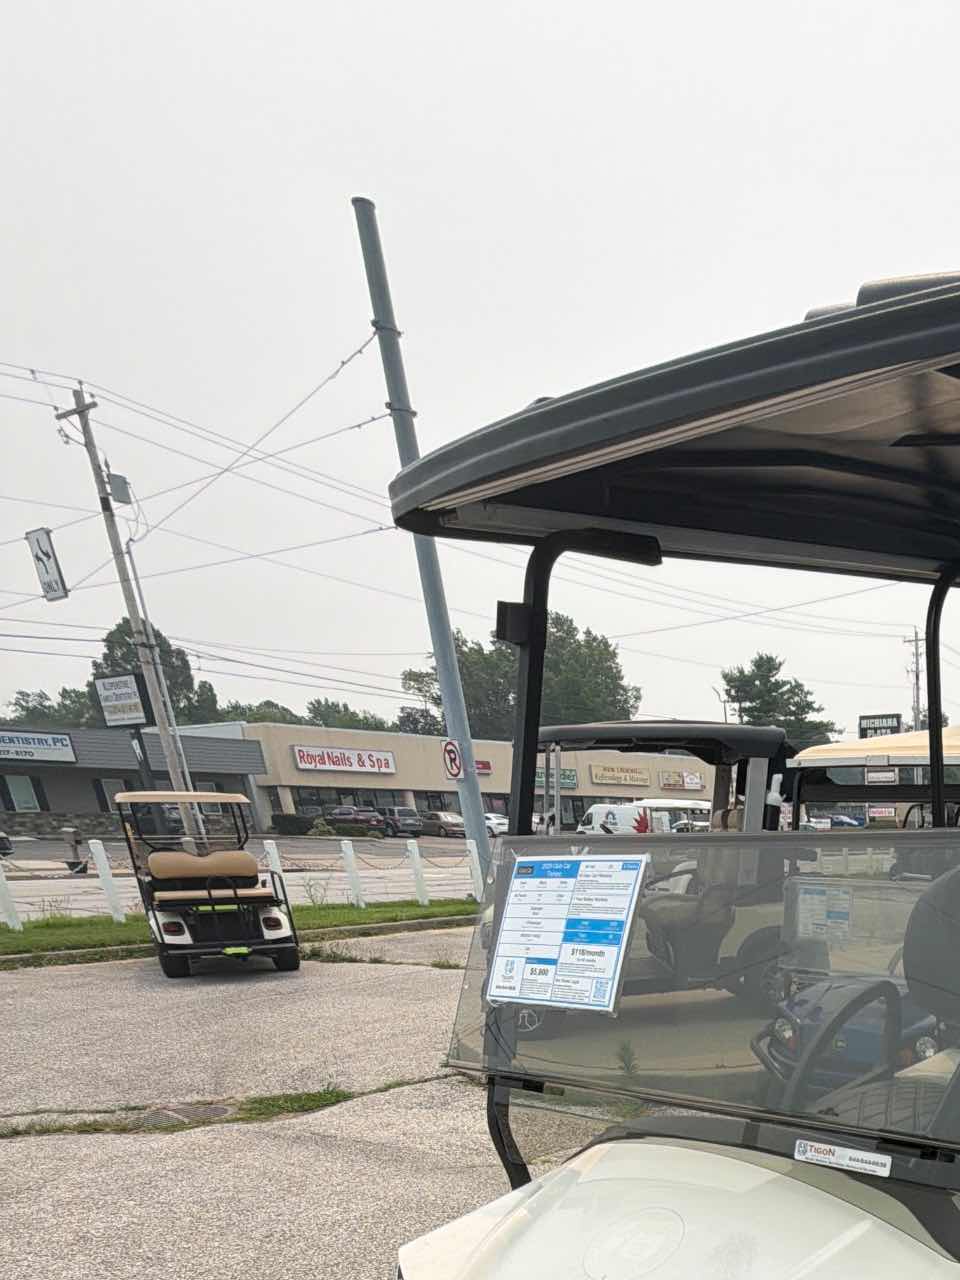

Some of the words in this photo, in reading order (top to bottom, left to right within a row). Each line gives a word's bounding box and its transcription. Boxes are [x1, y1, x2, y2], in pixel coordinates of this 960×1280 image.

[861, 718, 897, 728] MICHIANA
[298, 749, 326, 768] Royal
[327, 751, 353, 767] Nails
[357, 753, 366, 768] &
[368, 754, 390, 773] Spa
